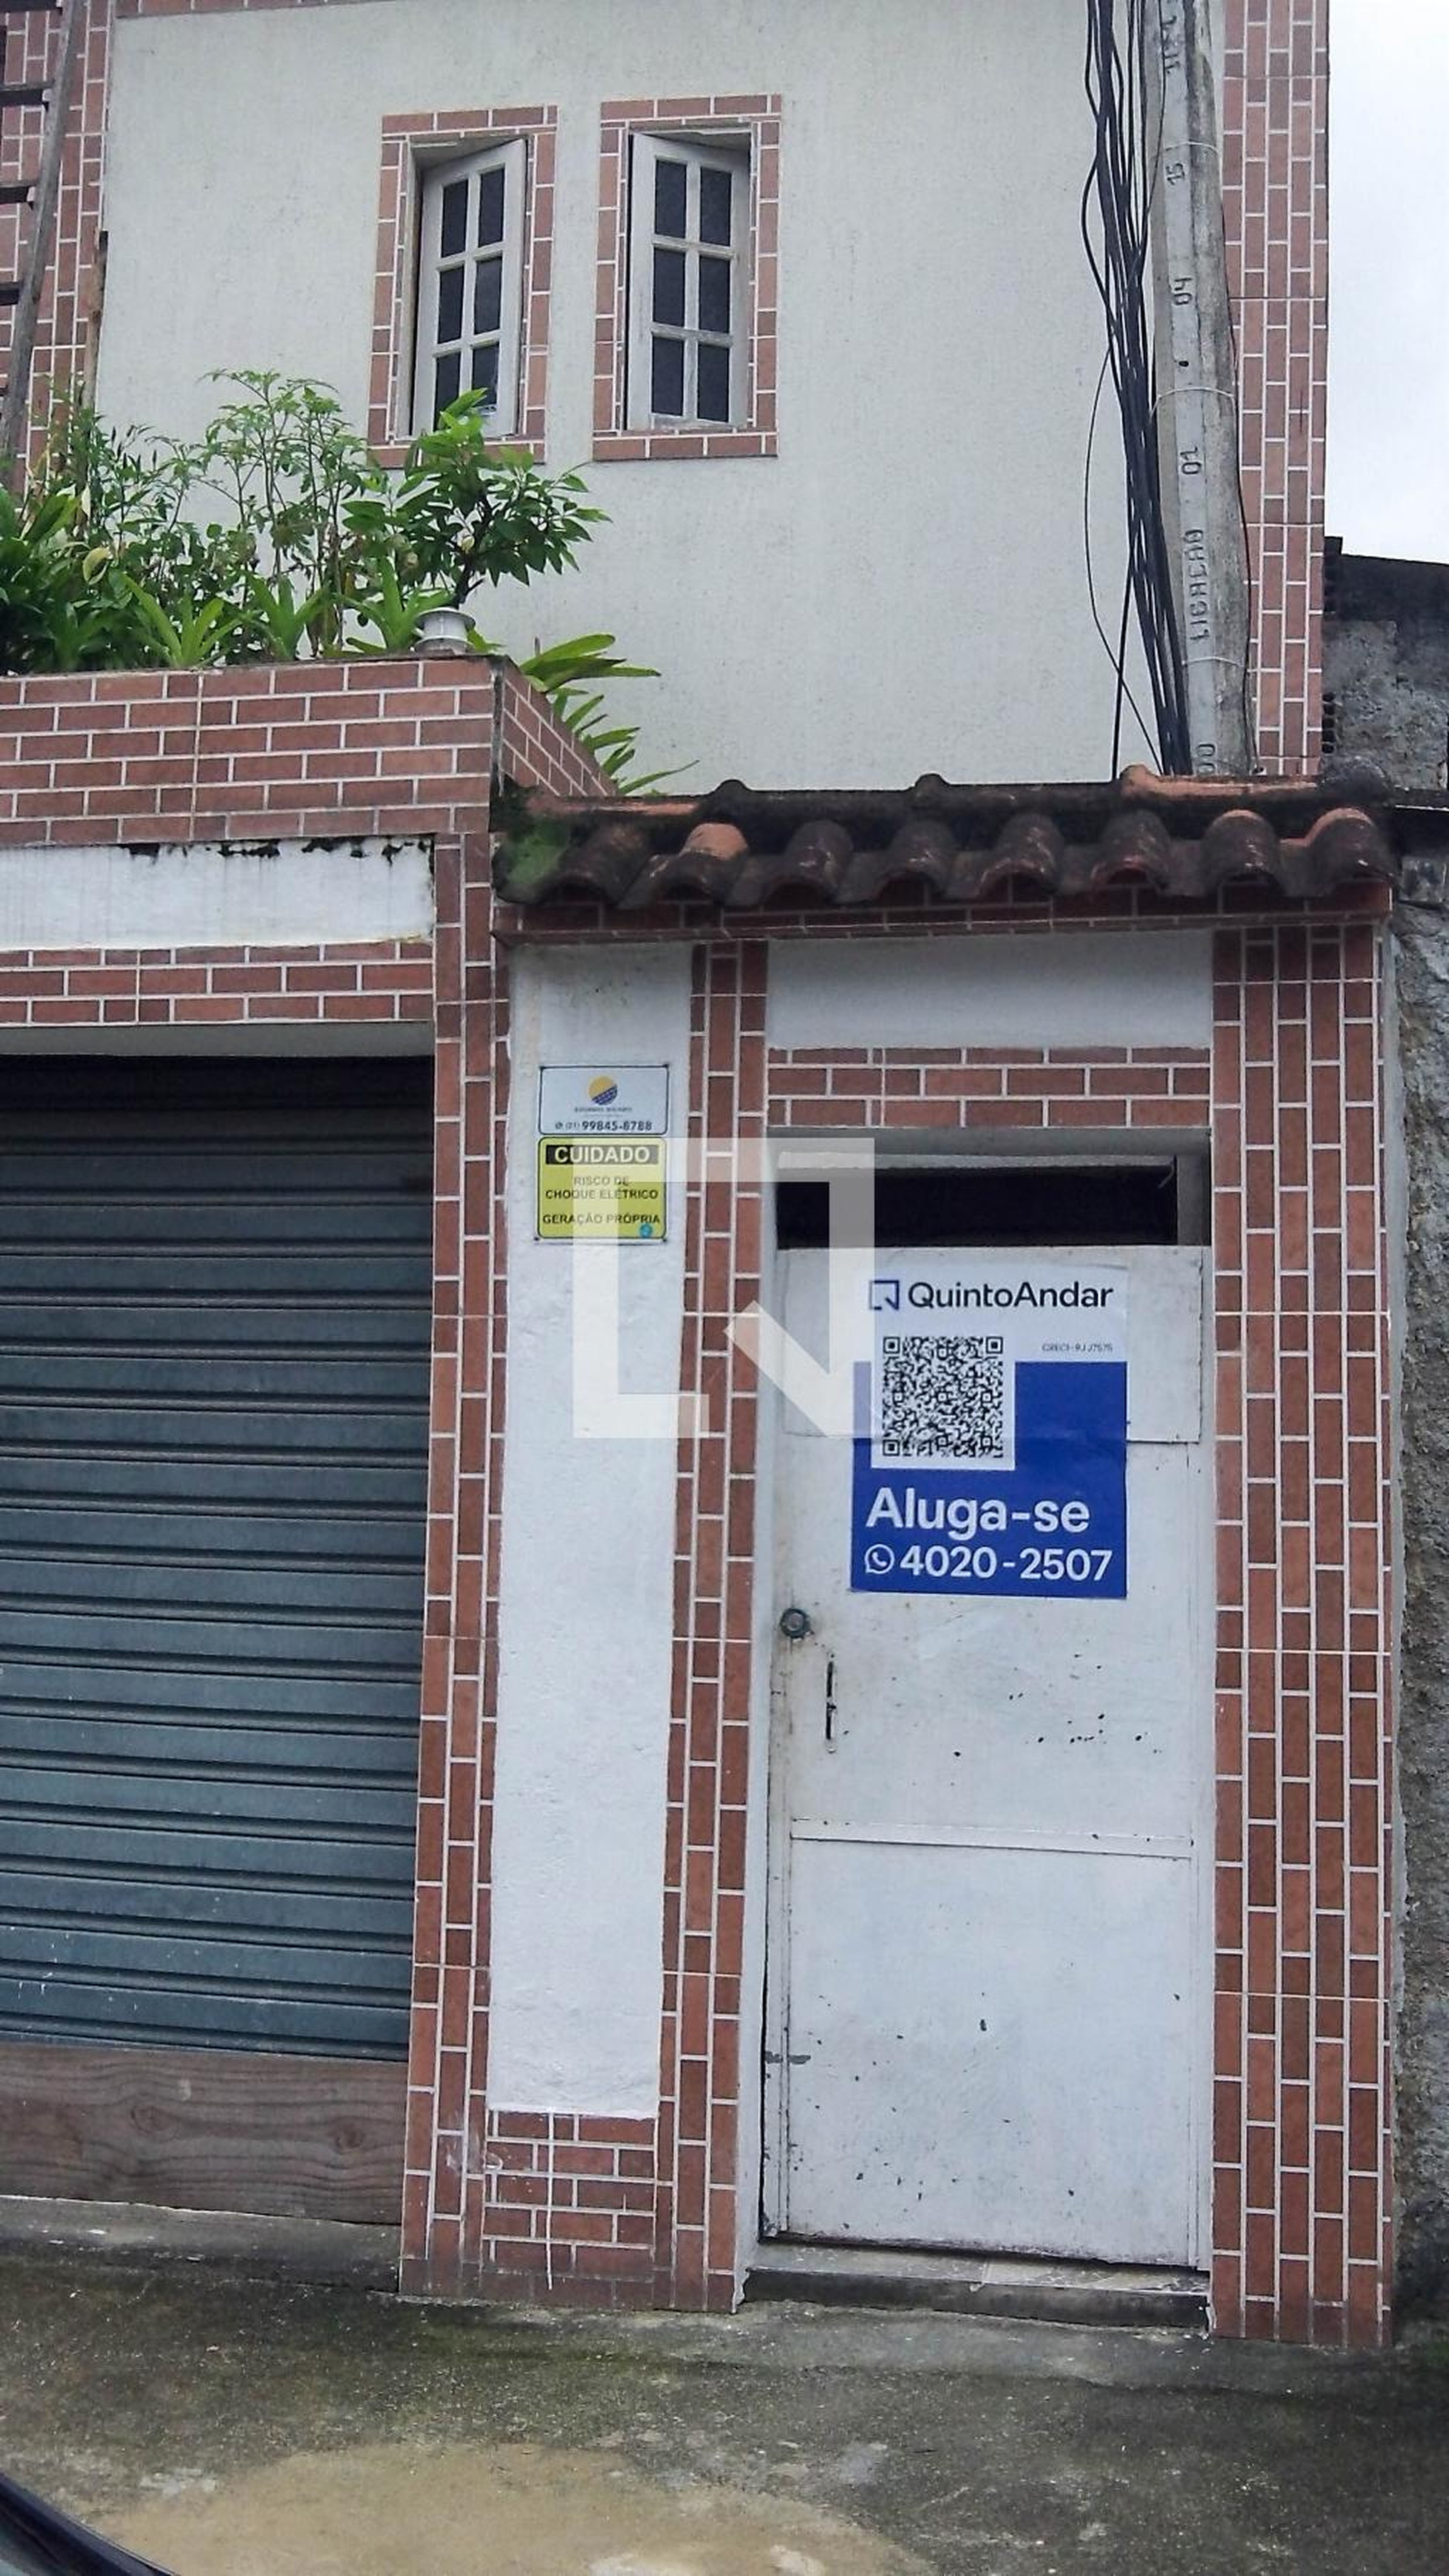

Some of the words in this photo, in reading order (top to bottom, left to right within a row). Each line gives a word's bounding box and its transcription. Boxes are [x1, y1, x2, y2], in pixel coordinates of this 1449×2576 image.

[1173, 277, 1192, 305] 04
[555, 1146, 650, 1163] CUIDADO
[574, 1176, 610, 1186] RISCO
[614, 1176, 629, 1186] DE
[545, 1189, 595, 1199] CHOQUE
[600, 1188, 658, 1199] ELÉTRICO
[543, 1212, 603, 1226] GERAÇÃO
[606, 1212, 660, 1224] PRÓPRIA
[908, 1282, 1113, 1309] QuintoAndar
[865, 1487, 1090, 1540] Aluga-se
[900, 1545, 1113, 1581] 4020-2507
